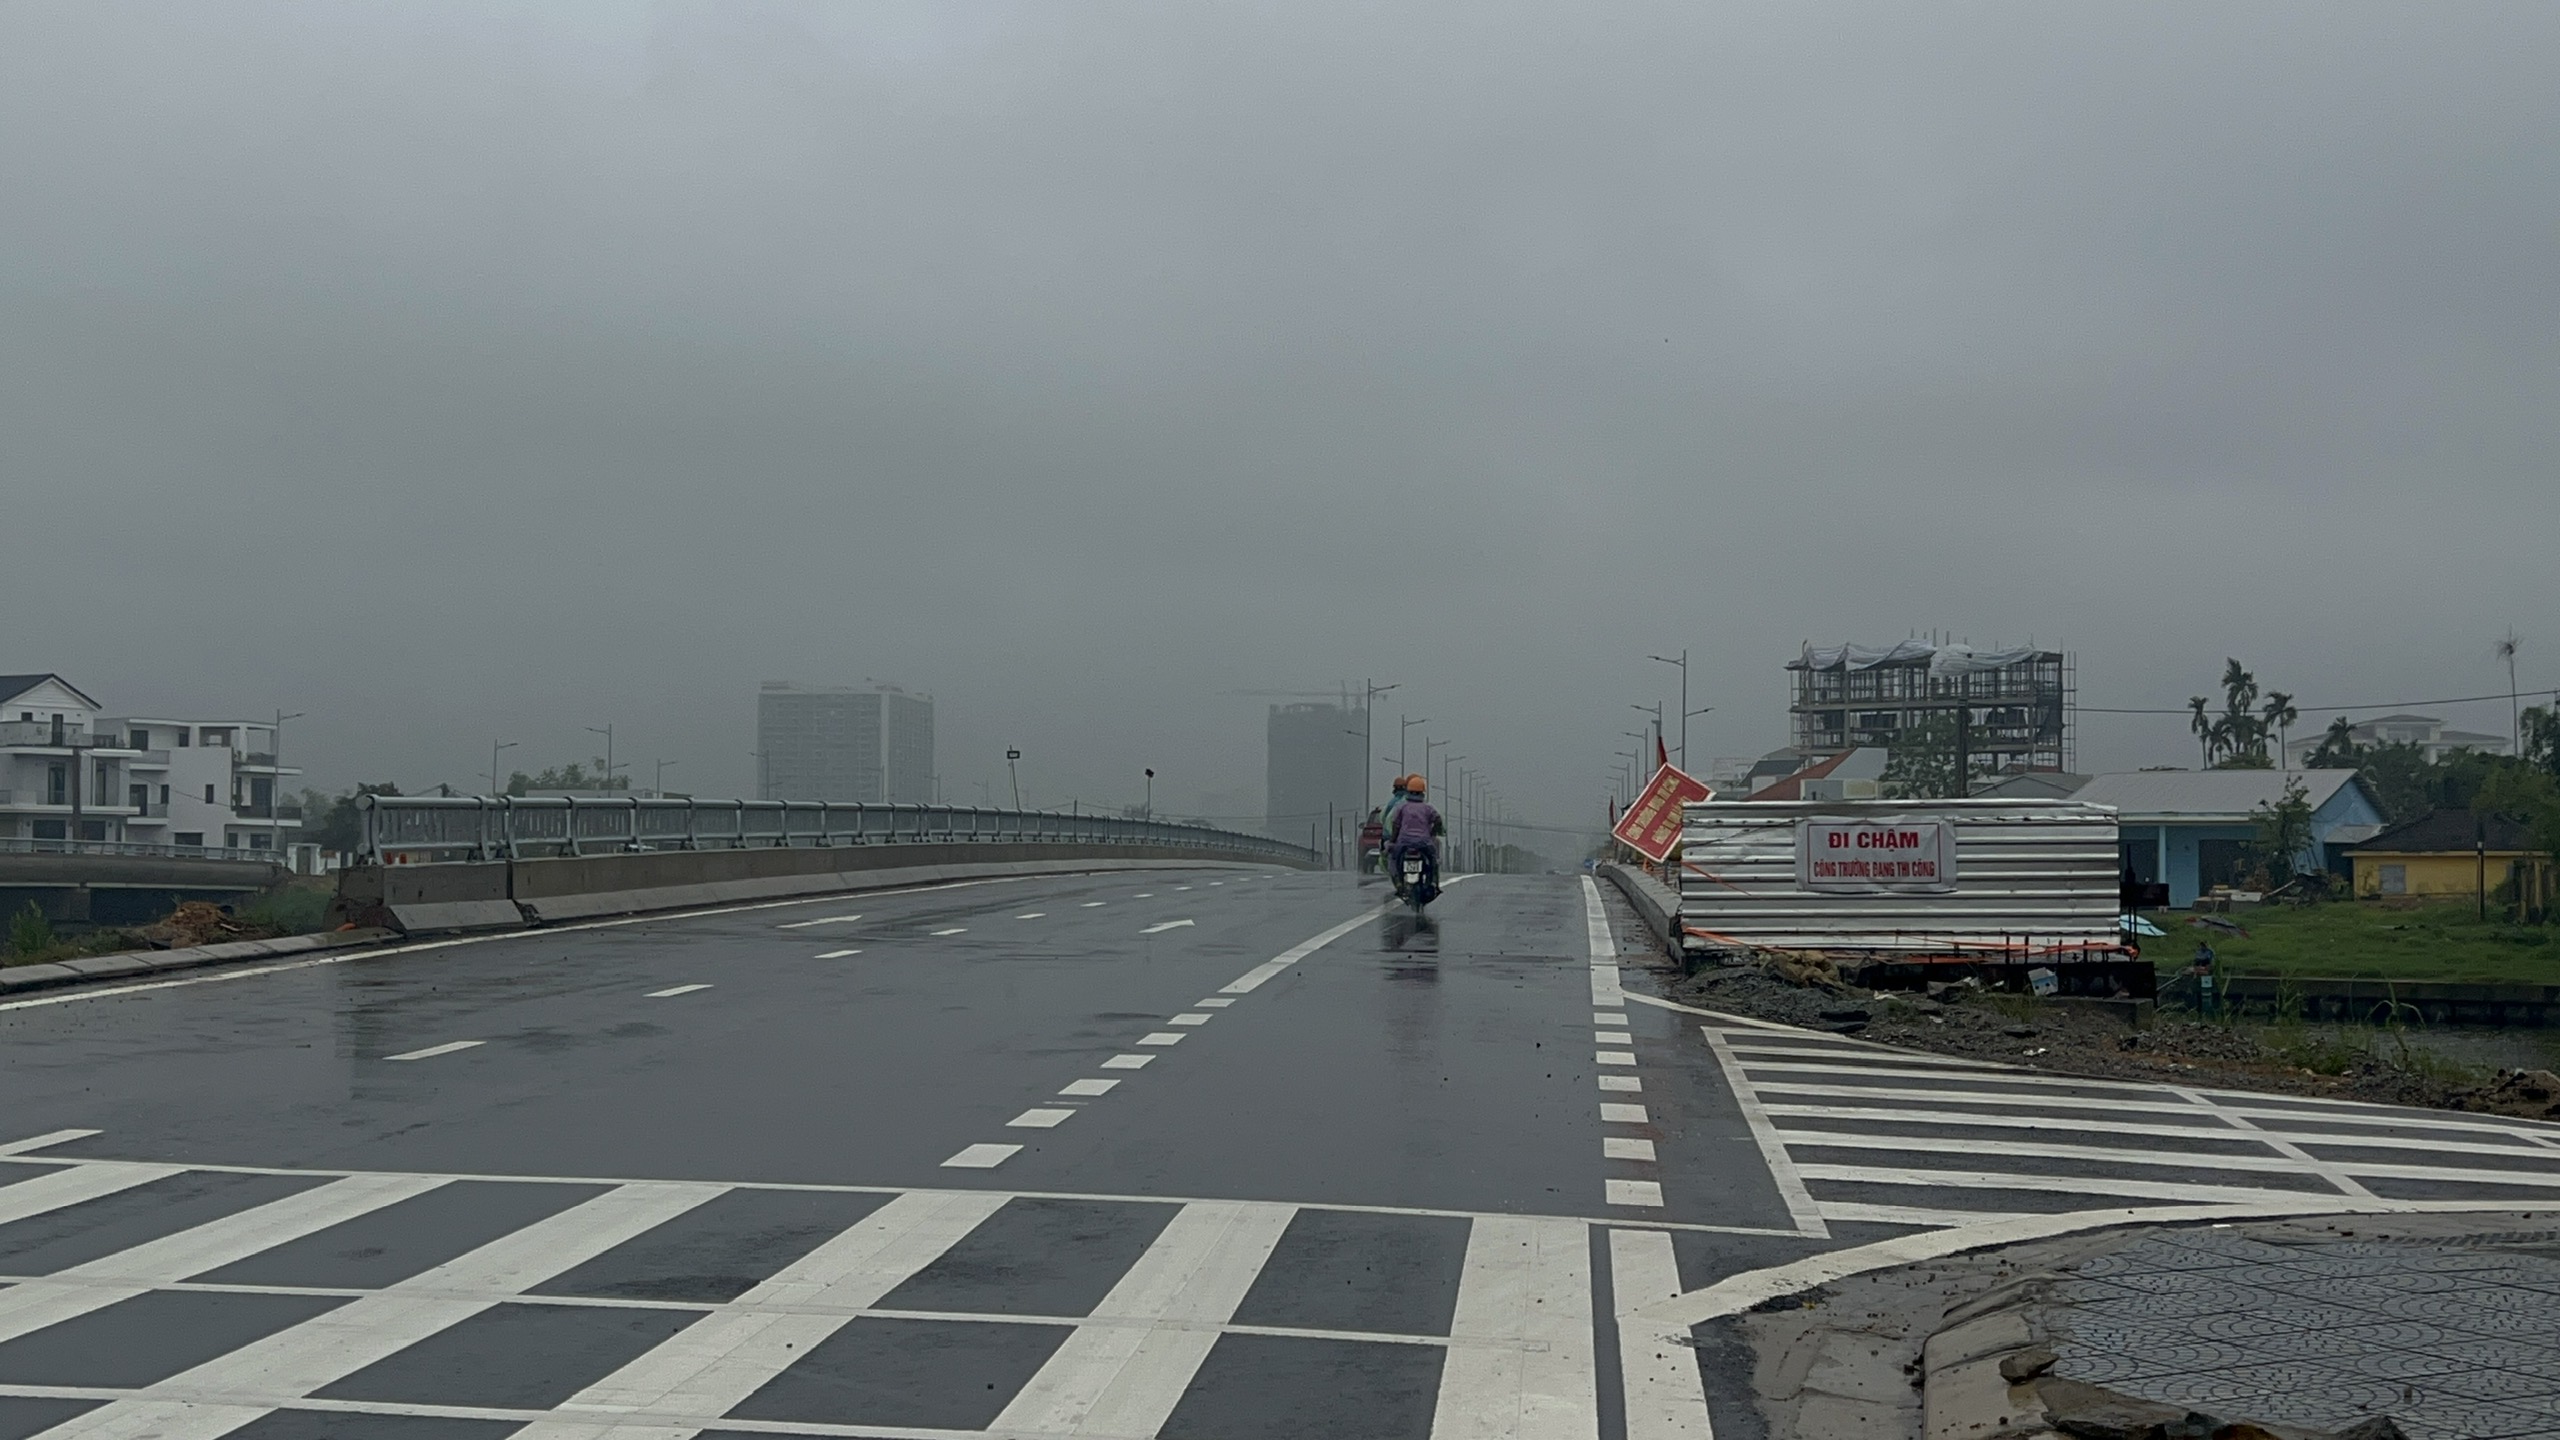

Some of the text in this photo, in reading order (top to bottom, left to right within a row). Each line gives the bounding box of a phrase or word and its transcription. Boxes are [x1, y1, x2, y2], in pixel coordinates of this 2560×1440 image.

[1828, 829, 1919, 852] ĐI CHẬM
[1813, 859, 1837, 877] CÔNG
[1838, 857, 1871, 877] TRƯỜNG
[1897, 861, 1910, 877] THI
[1912, 858, 1936, 877] CÔNG
